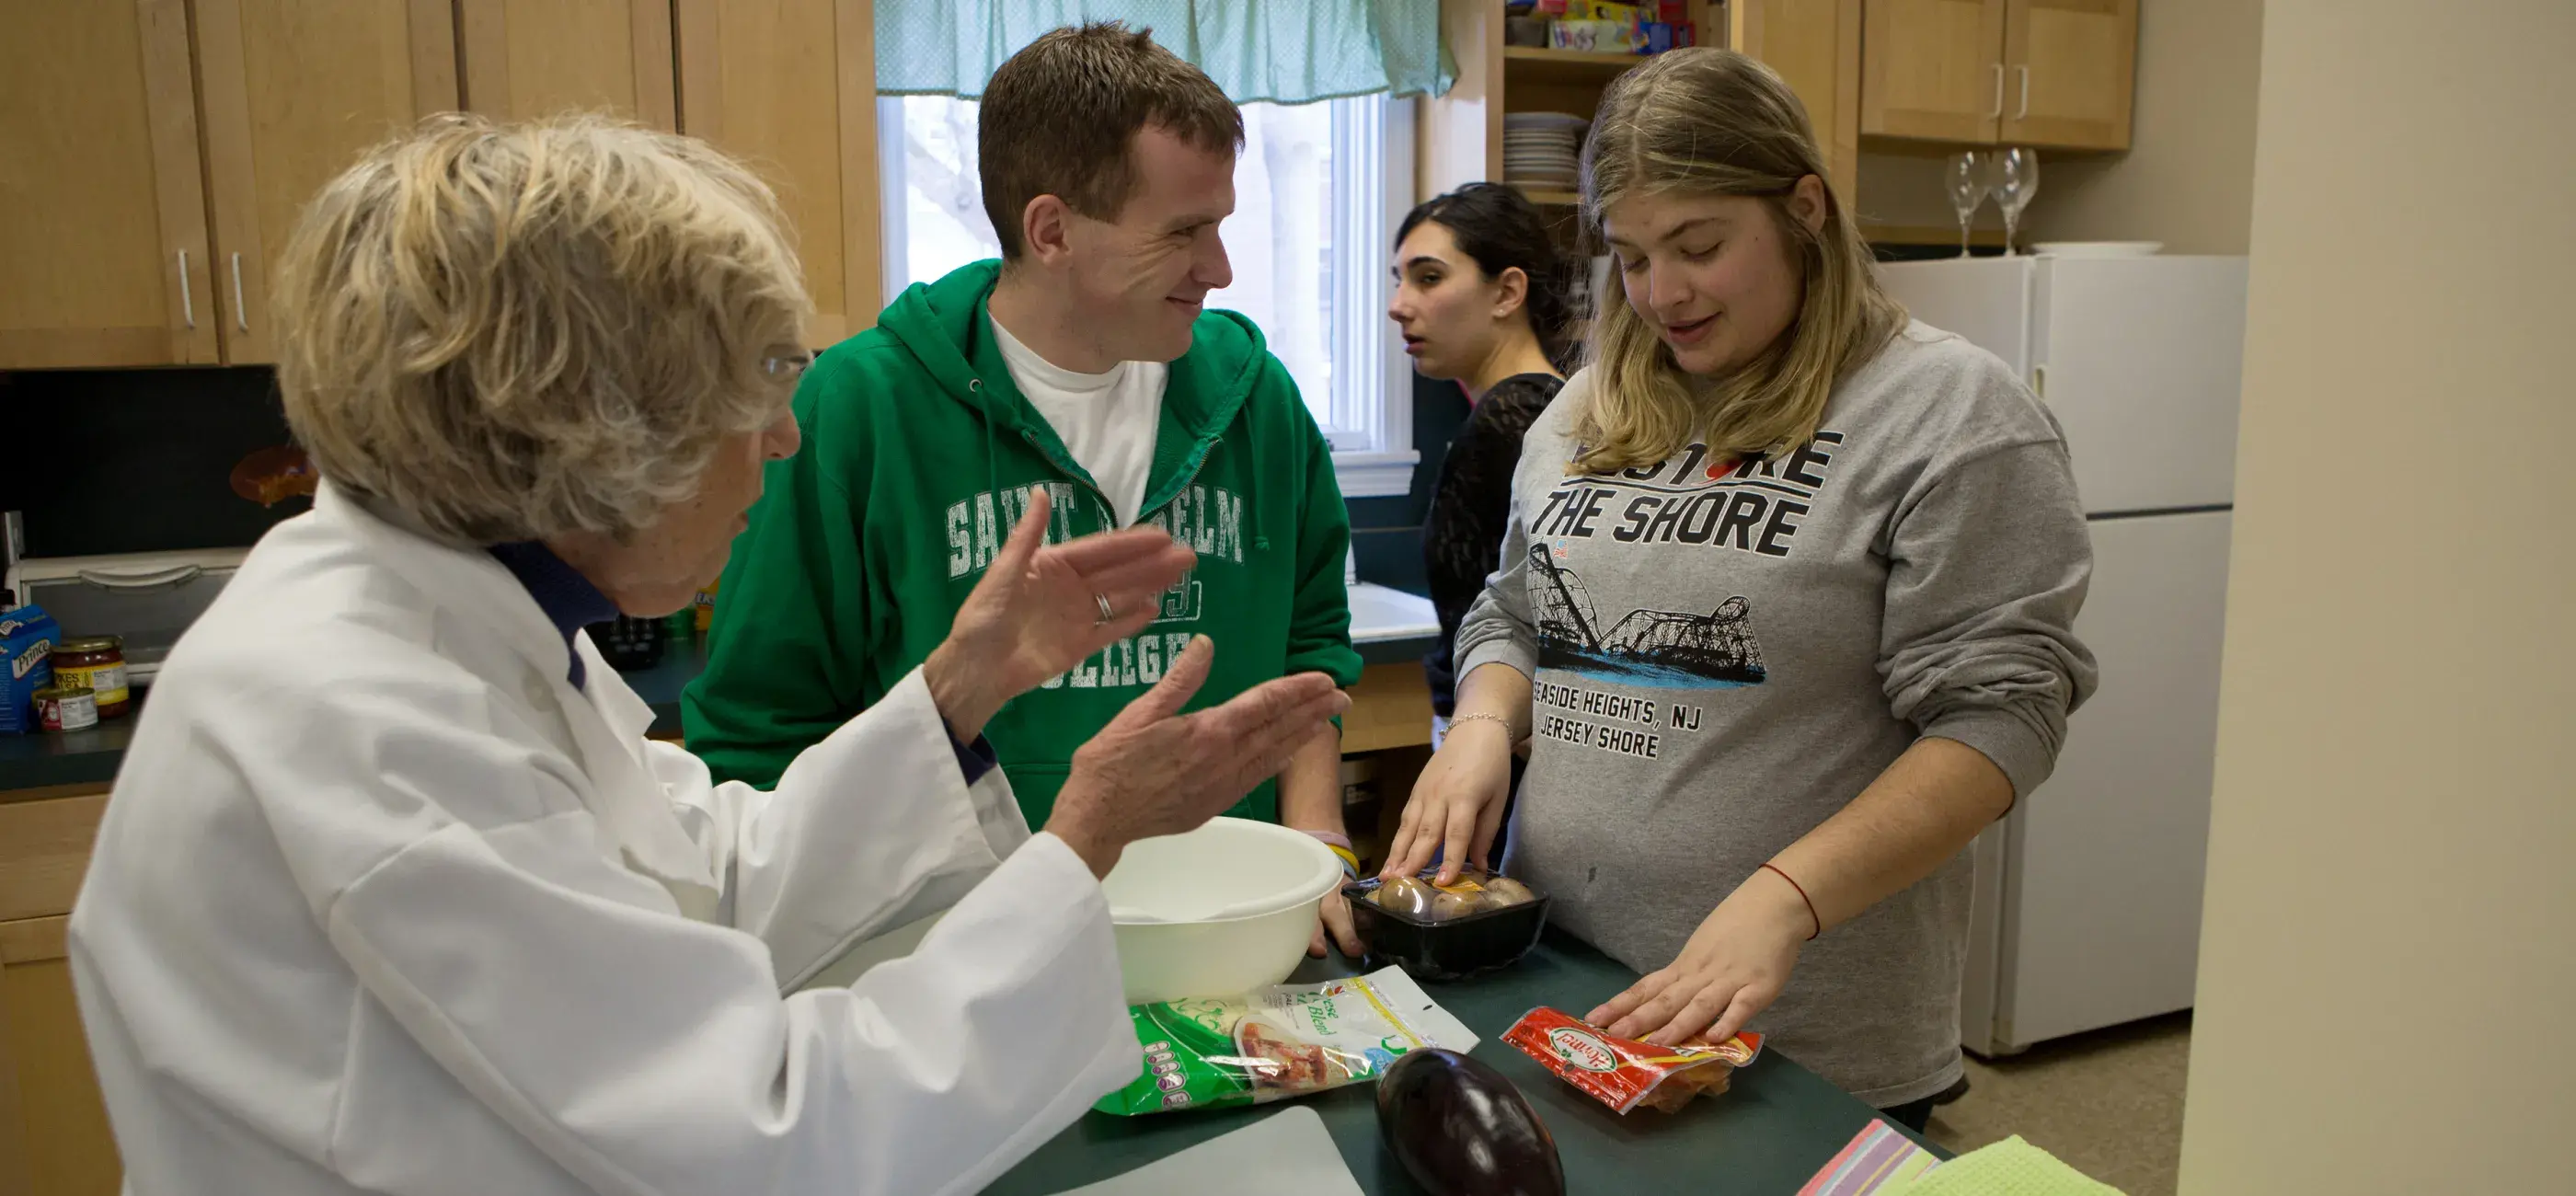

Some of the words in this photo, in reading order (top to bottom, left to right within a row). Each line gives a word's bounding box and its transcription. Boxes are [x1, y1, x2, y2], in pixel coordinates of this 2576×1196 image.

[1530, 488, 1618, 538] THE
[1612, 490, 1811, 558] SHORE
[17, 640, 50, 672] Prince
[1534, 681, 1580, 710] SEASIDE
[1582, 691, 1661, 730] HEIGHTS,
[1672, 705, 1702, 730] NJ
[1540, 715, 1594, 746] JERSEY
[1597, 726, 1660, 759] SHORE
[1306, 1005, 1338, 1036] Blend
